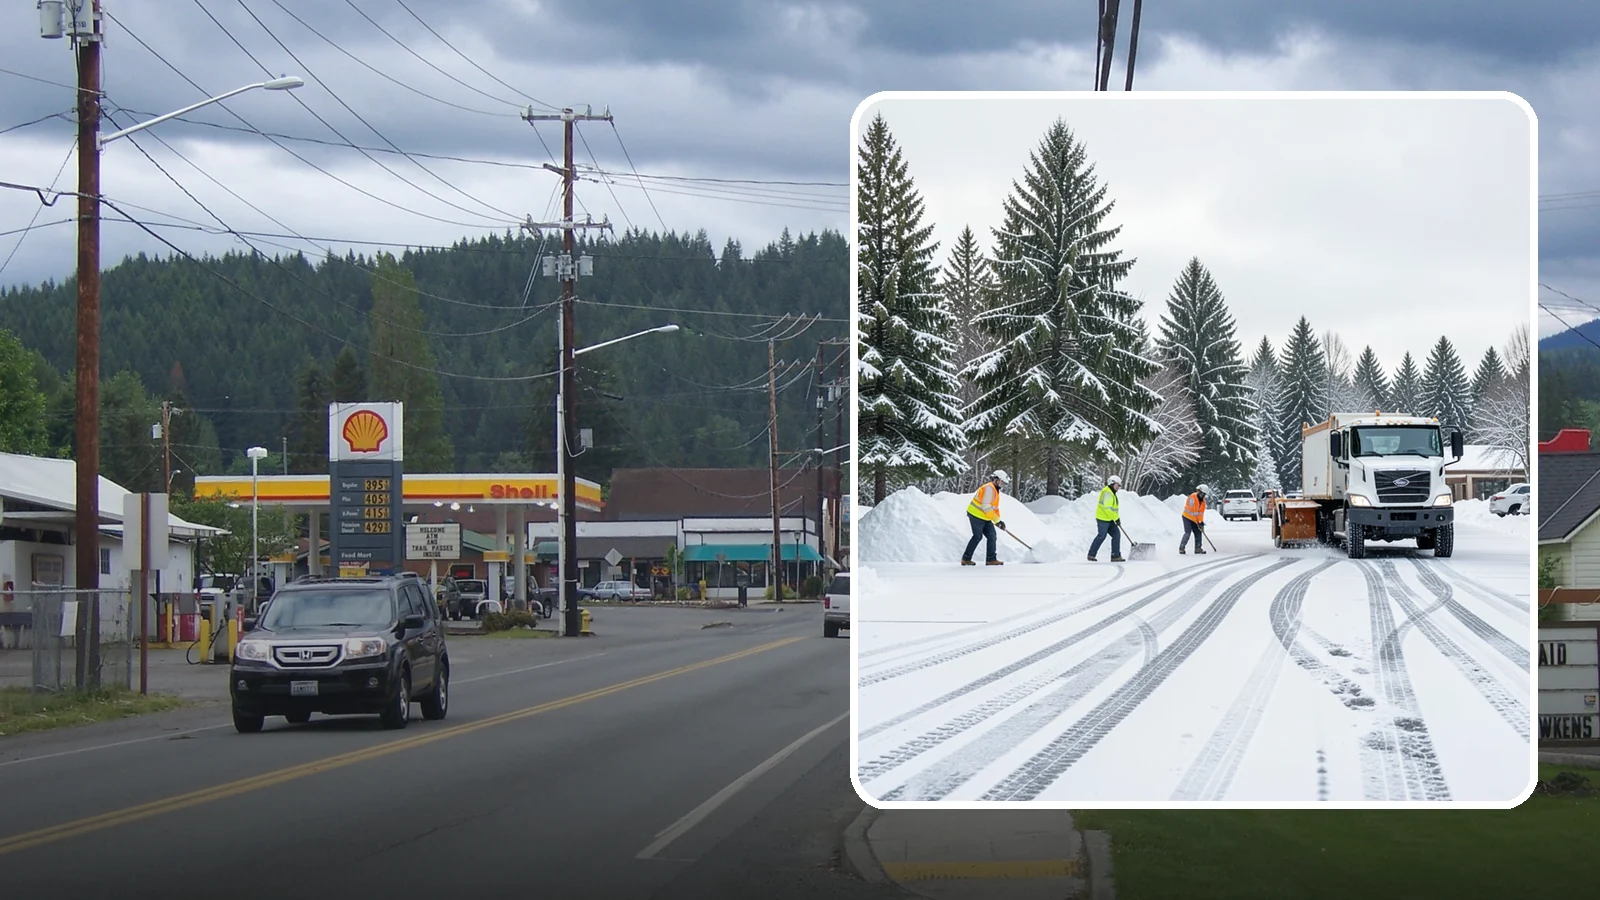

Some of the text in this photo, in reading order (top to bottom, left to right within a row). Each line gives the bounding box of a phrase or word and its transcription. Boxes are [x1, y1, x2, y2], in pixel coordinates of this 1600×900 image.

[366, 480, 383, 490] 395
[490, 484, 547, 499] Shell
[366, 494, 383, 504] 405
[366, 508, 383, 518] 415
[366, 522, 383, 532] 429
